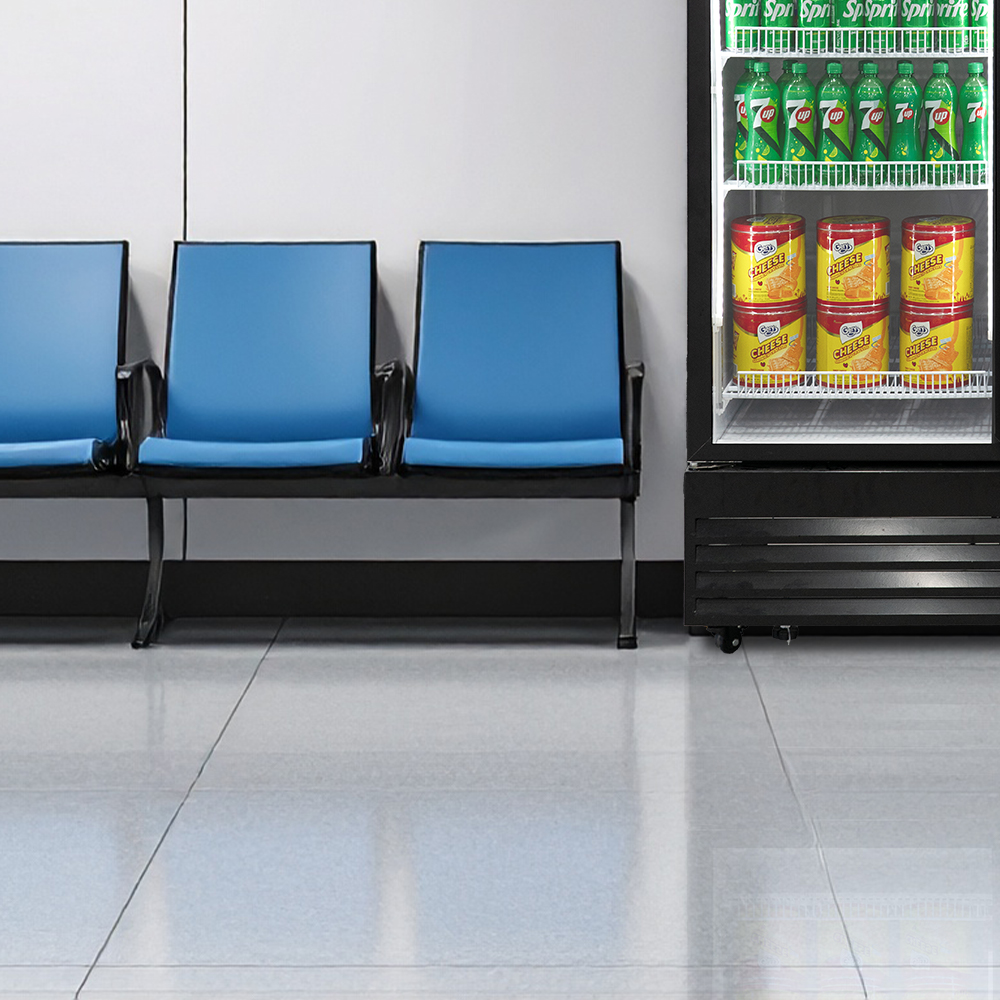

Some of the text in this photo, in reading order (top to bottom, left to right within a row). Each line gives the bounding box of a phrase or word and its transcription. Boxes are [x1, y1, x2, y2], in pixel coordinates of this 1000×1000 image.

[748, 253, 785, 277] CHEESE
[827, 252, 862, 276] CHEESE
[909, 254, 943, 276] CHEESE
[750, 334, 788, 359] CHEESE
[833, 335, 870, 360] CHEESE
[905, 336, 938, 358] CHEESE
